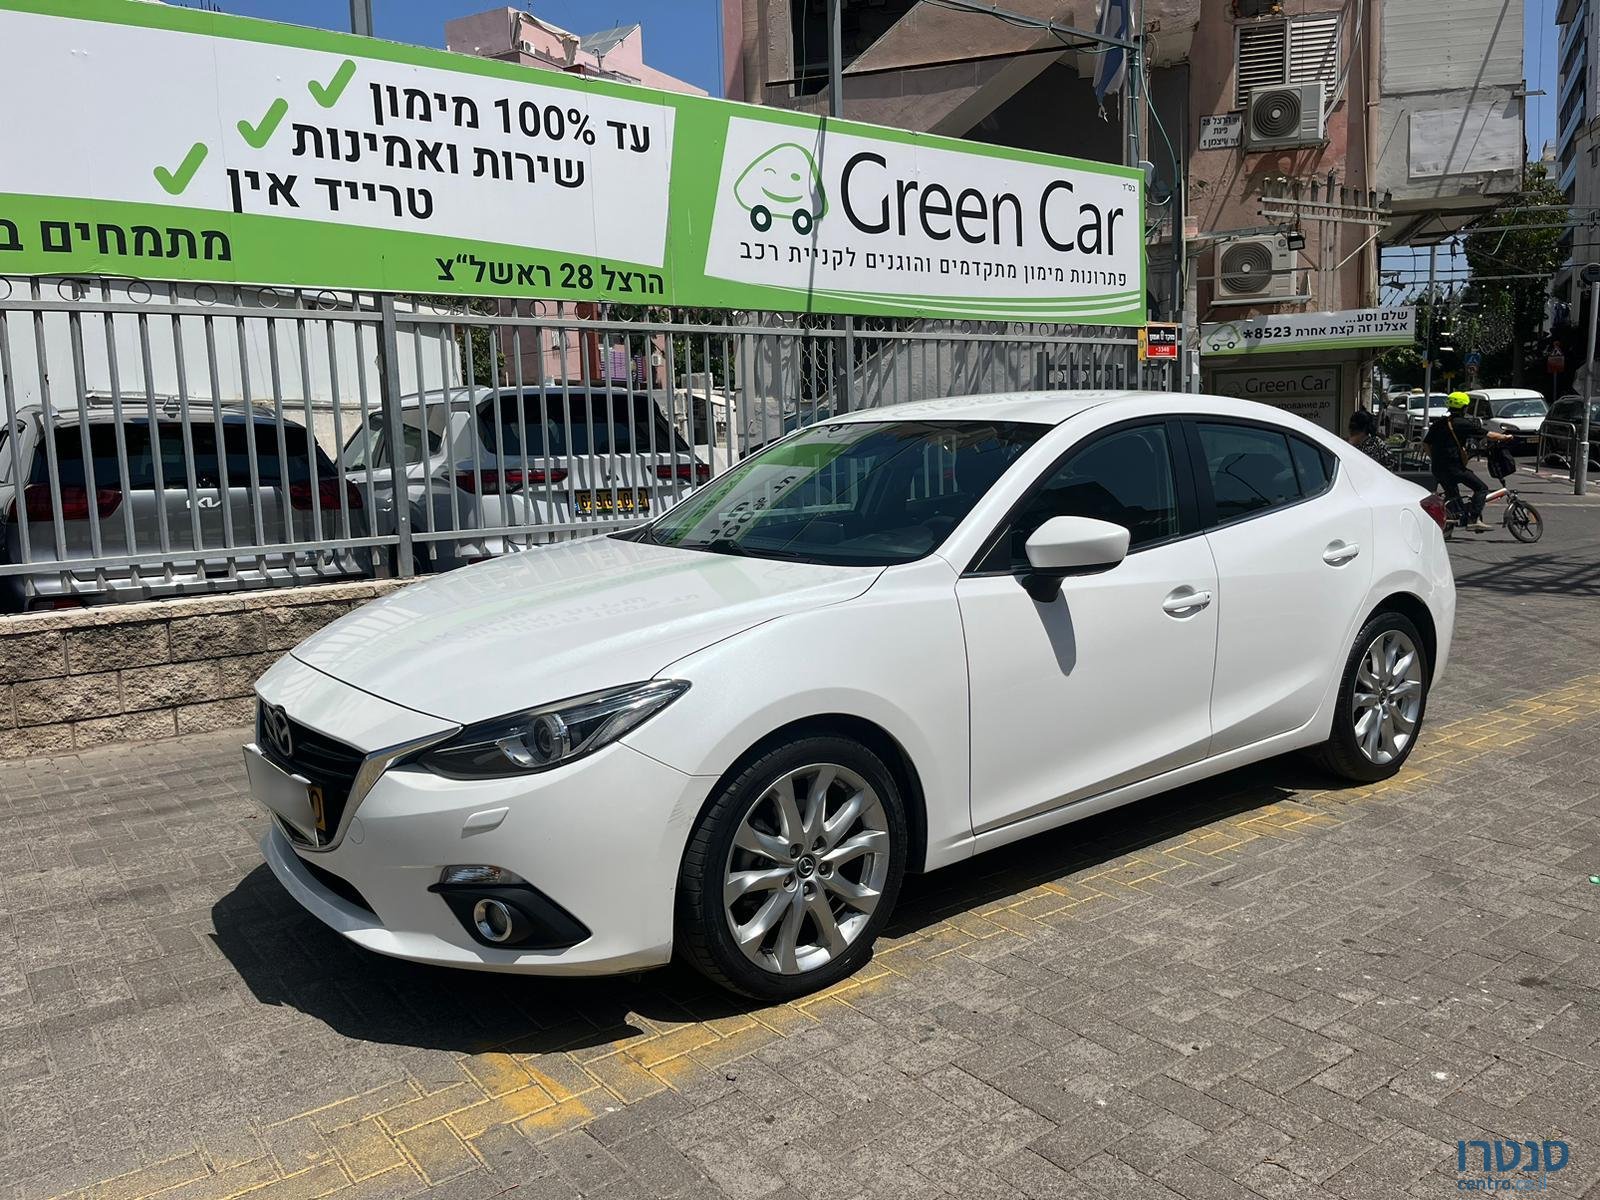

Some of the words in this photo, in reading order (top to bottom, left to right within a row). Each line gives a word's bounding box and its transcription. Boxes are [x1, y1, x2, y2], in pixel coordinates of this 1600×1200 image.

[369, 82, 480, 129] מימון
[494, 97, 596, 146] 100%
[606, 119, 651, 153] עד
[291, 122, 459, 175] ואמינות
[473, 146, 585, 188] שירות
[226, 168, 300, 214] אין
[314, 177, 433, 220] טרייד
[841, 151, 1023, 248] Green
[1039, 180, 1124, 256] Car
[40, 220, 232, 262] מתמחים
[740, 241, 779, 262] רכב
[788, 246, 856, 271] לקניית
[866, 252, 931, 273] והוגנים
[940, 258, 1017, 282] מתקדמים
[560, 262, 594, 290] 28
[601, 264, 664, 295] הרצל
[1023, 265, 1064, 284] מימון
[1070, 269, 1127, 287] פתרונות
[1374, 321, 1408, 332] אצלנו
[1381, 310, 1408, 321] שלם
[1295, 326, 1327, 337] אחרת
[1330, 325, 1355, 337] קצת
[1358, 324, 1372, 333] זה
[1245, 377, 1297, 394] Green
[1301, 375, 1331, 391] Car
[1319, 401, 1330, 409] до
